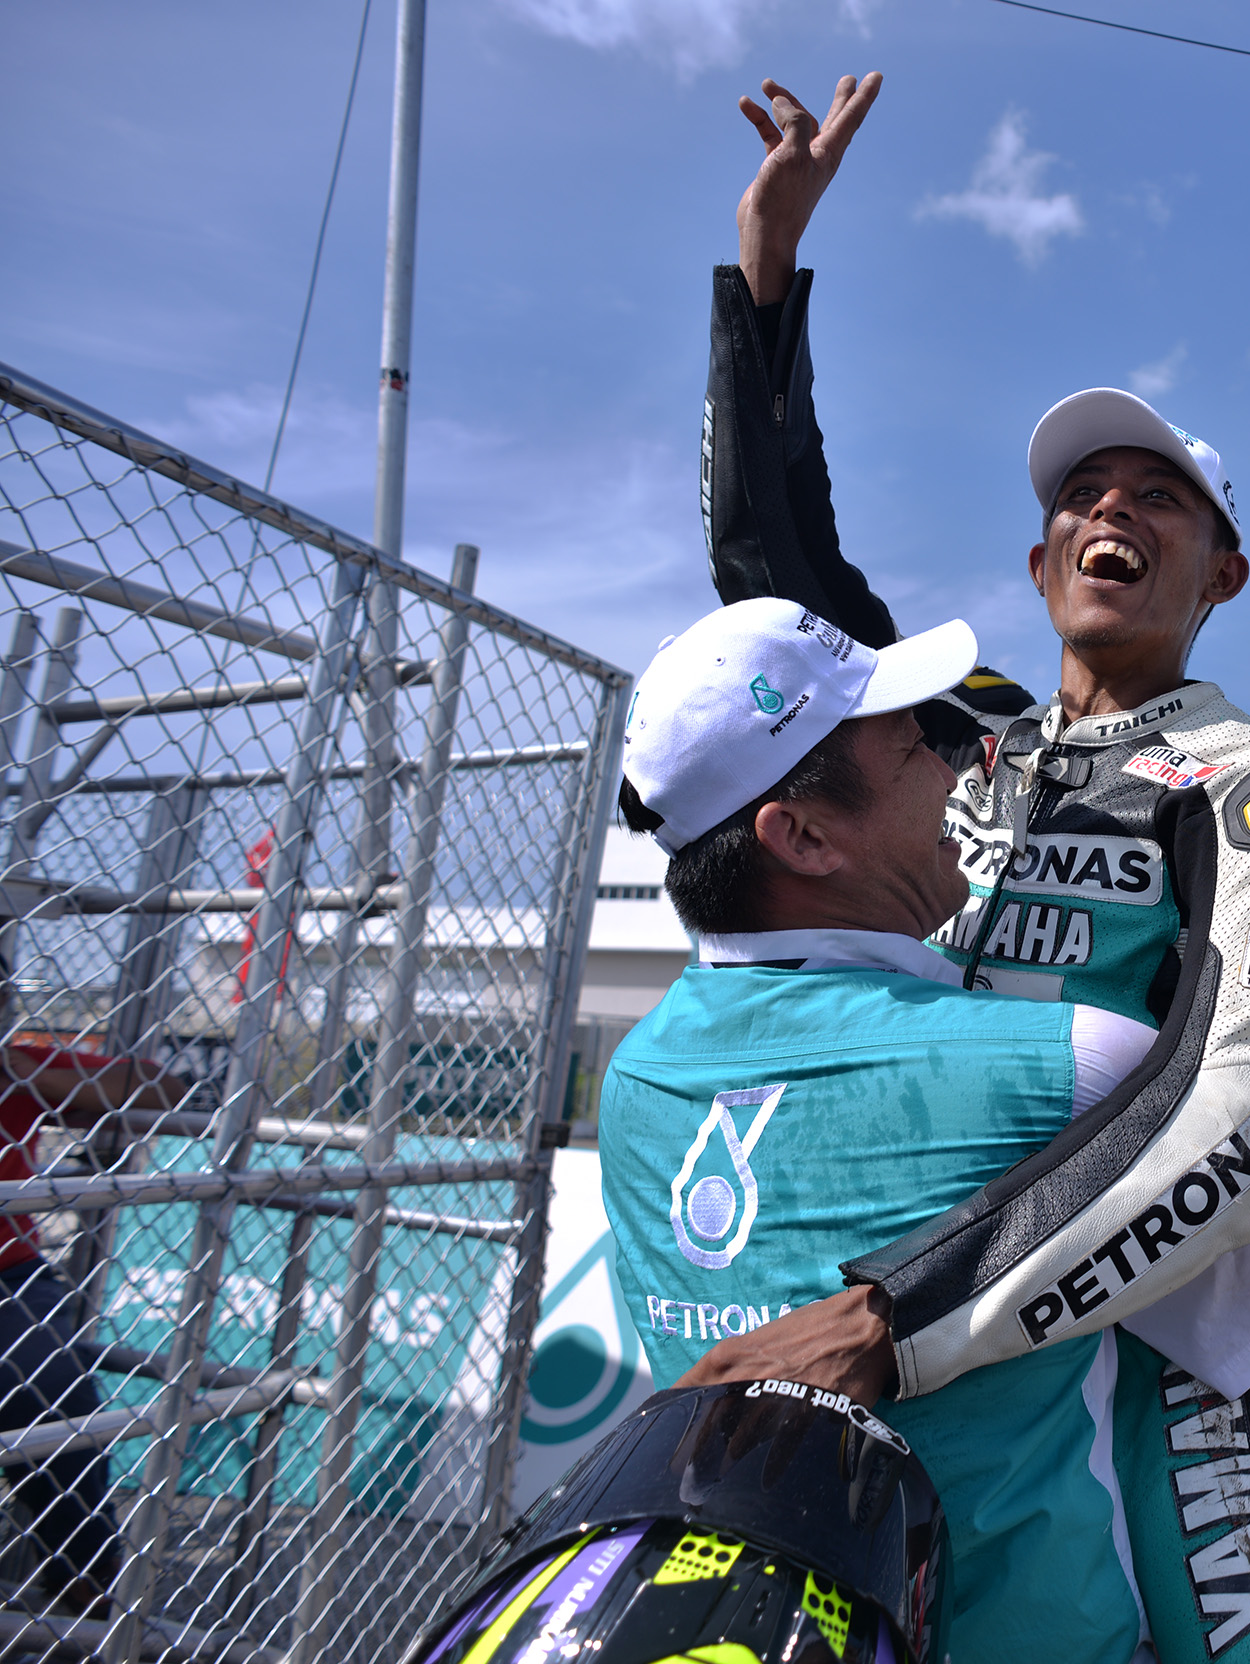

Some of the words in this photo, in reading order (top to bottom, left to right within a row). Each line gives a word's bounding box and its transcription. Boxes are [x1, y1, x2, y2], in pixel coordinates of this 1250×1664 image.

[769, 694, 809, 736] PETRONAS
[1095, 698, 1184, 737] TAICHI
[1128, 757, 1188, 787] racing
[1140, 747, 1187, 768] uma
[931, 898, 1090, 964] AMAHA
[646, 1295, 824, 1341] PETRON
[810, 1388, 852, 1415] got
[588, 1539, 625, 1576] SITI
